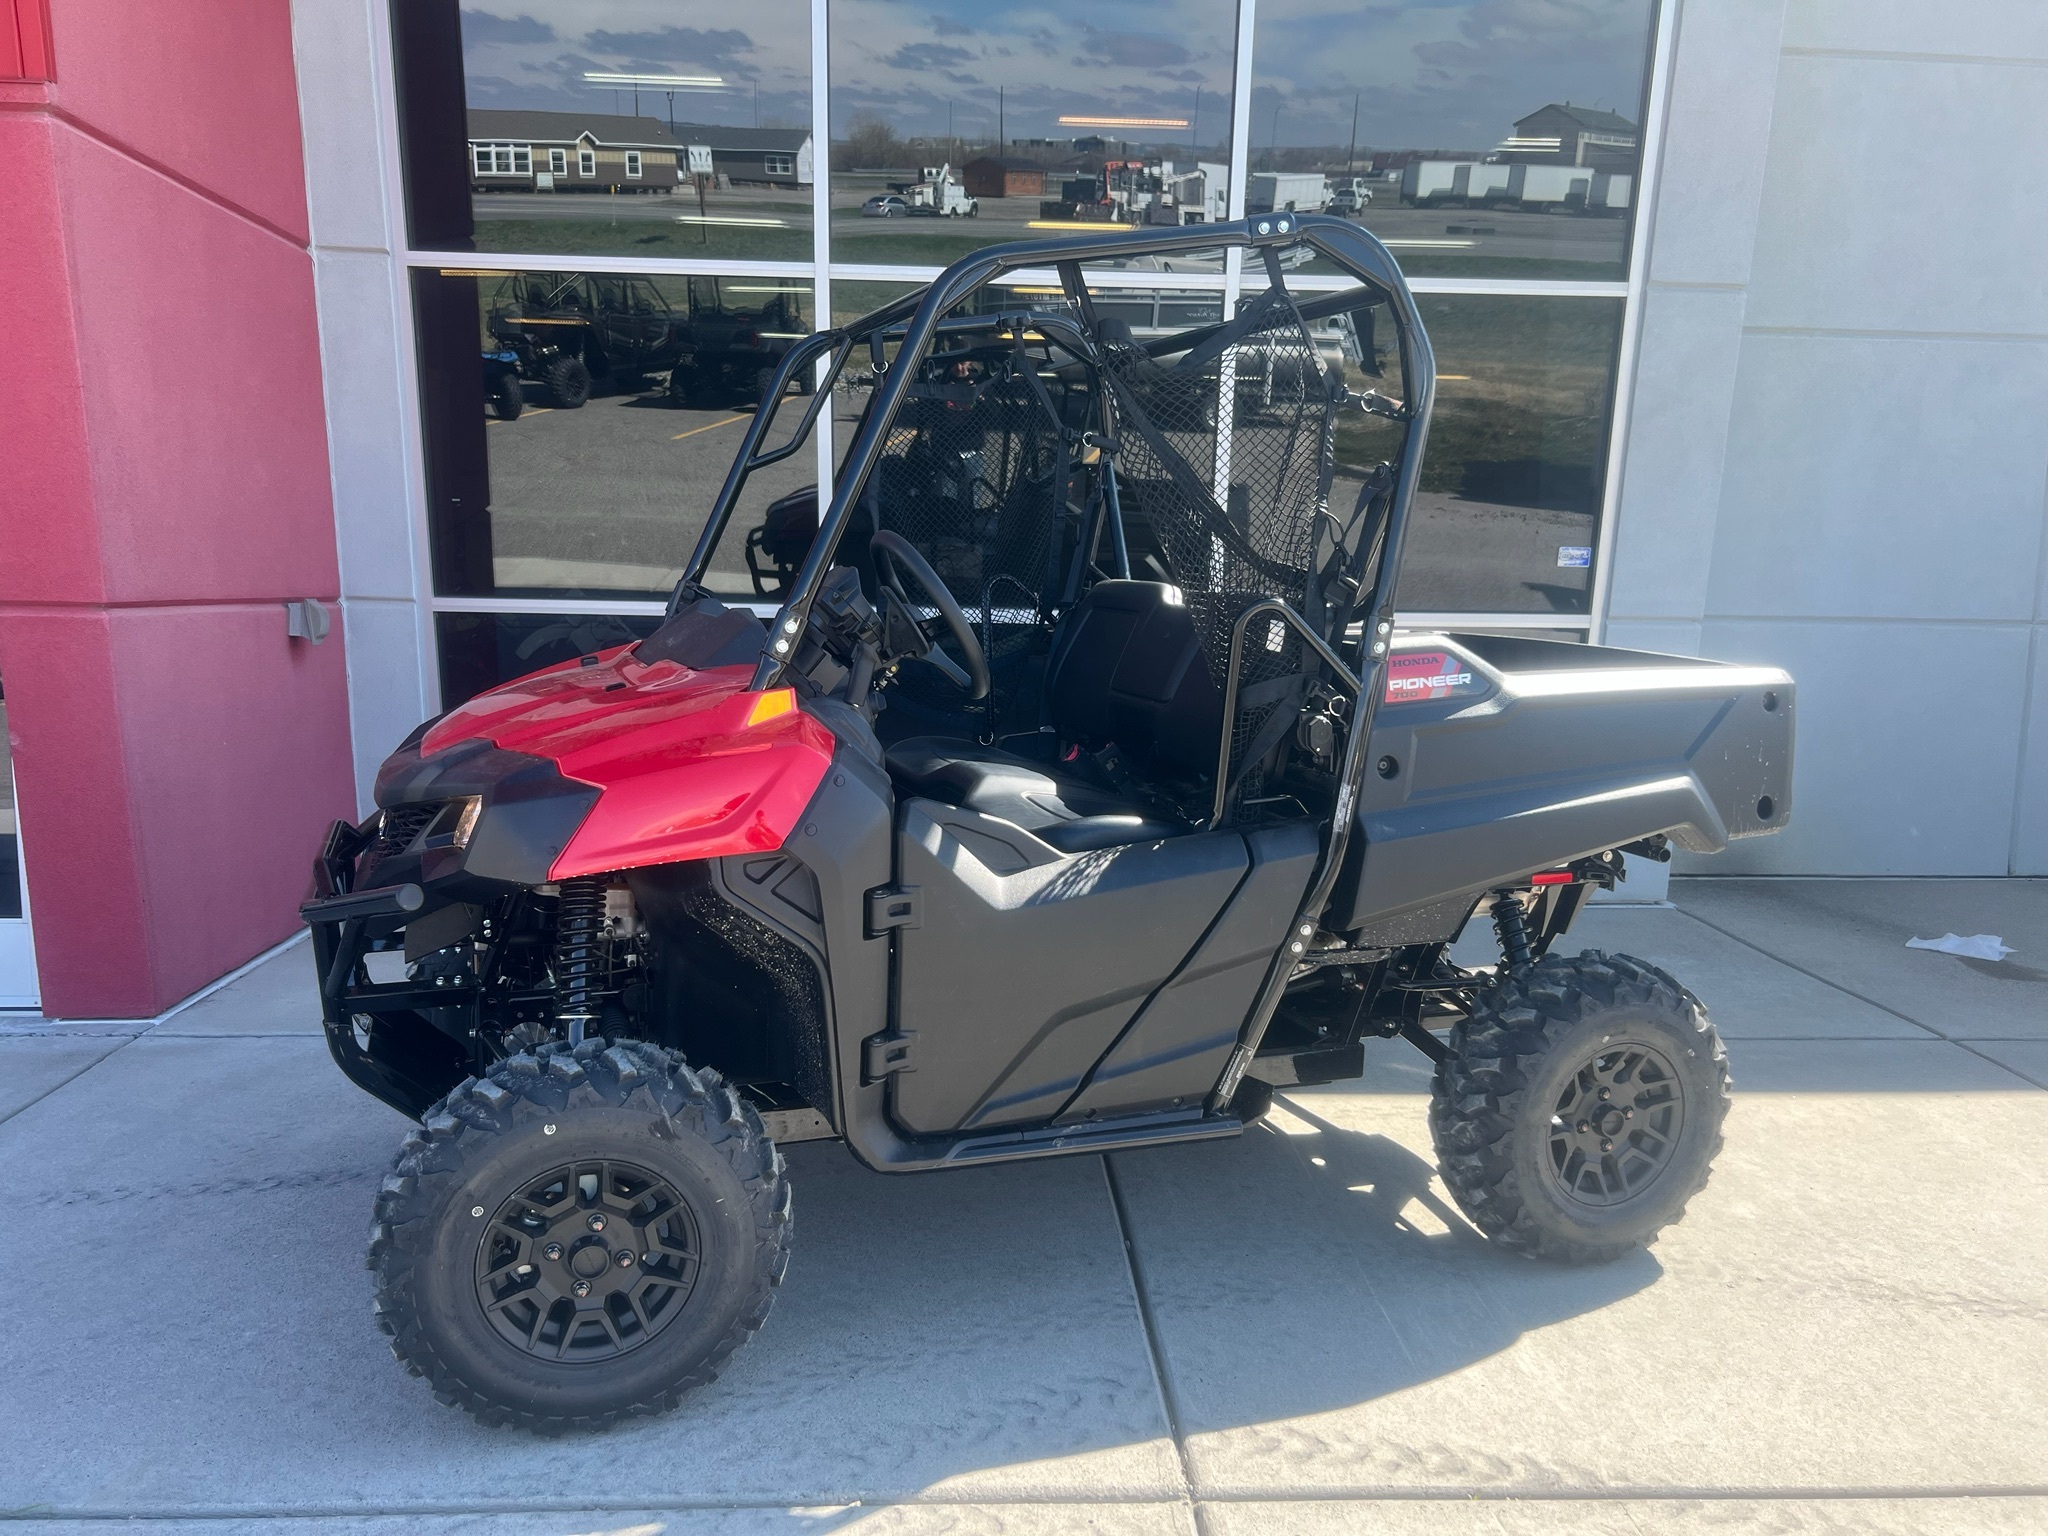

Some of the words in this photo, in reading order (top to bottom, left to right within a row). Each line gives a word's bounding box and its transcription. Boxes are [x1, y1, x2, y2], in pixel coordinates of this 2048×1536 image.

[1392, 657, 1439, 668] HONDA
[1389, 673, 1472, 691] PIONEER
[1391, 690, 1418, 699] 700
